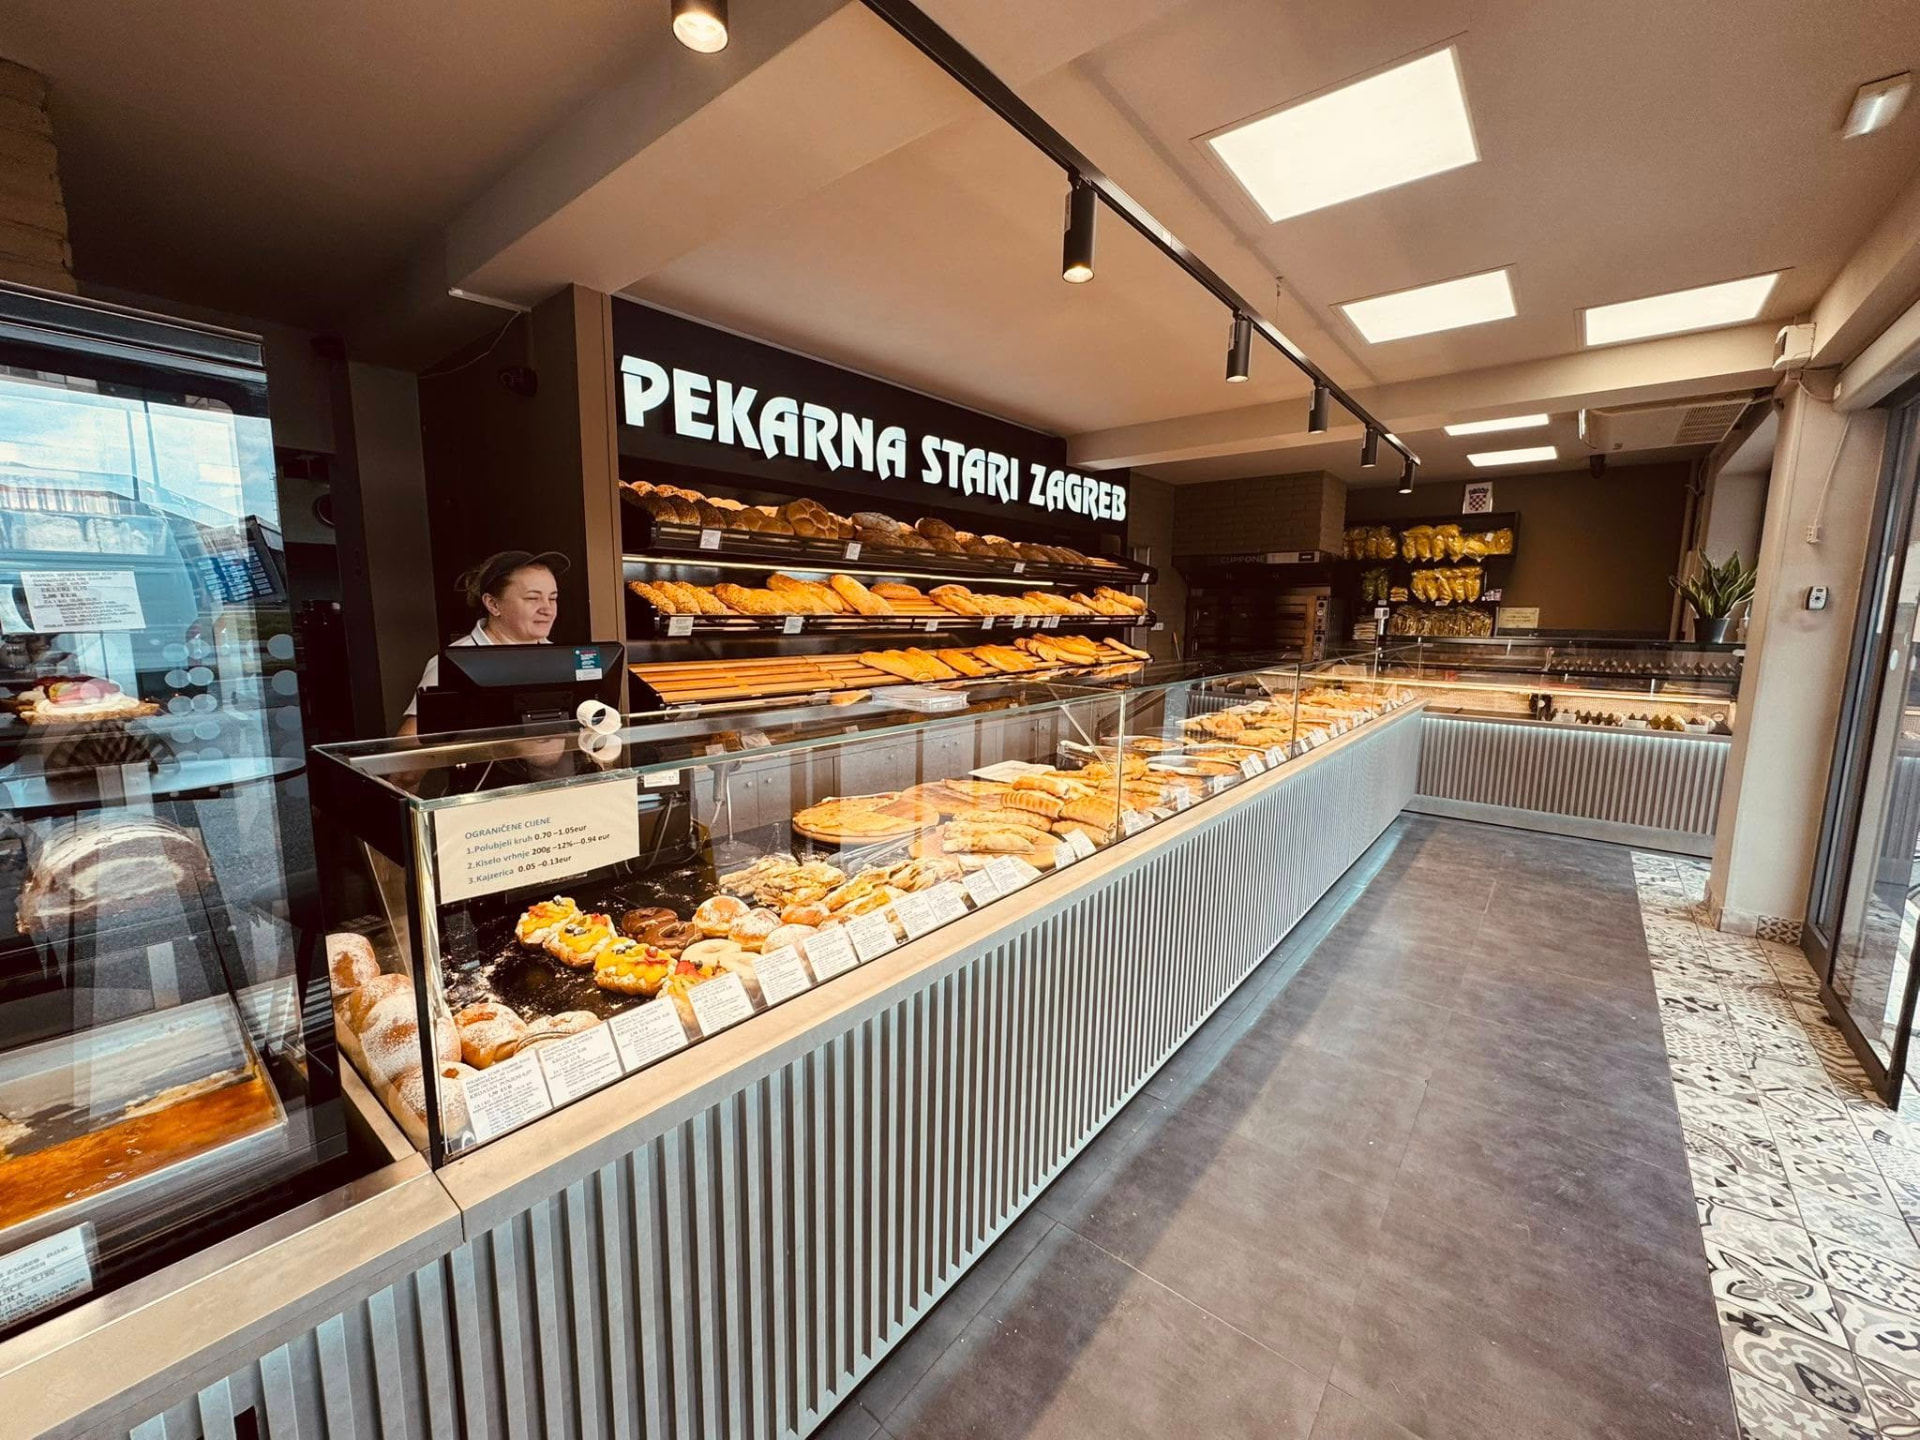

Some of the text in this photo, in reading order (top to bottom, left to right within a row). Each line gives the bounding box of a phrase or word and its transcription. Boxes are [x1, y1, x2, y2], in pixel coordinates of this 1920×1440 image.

[620, 355, 1126, 522] PEKARNA STARI ZAGREB
[465, 816, 551, 839] OGRANIČENE CIJENE
[466, 839, 512, 854] 1.Polubjeli
[514, 835, 533, 844] kruh
[534, 831, 552, 841] 0.70
[467, 857, 502, 870] 2.Kiselo
[503, 851, 530, 862] vrhnje
[531, 846, 551, 855] 200g
[468, 869, 514, 884] 3.Kajzerica
[517, 863, 536, 872] 0.05
